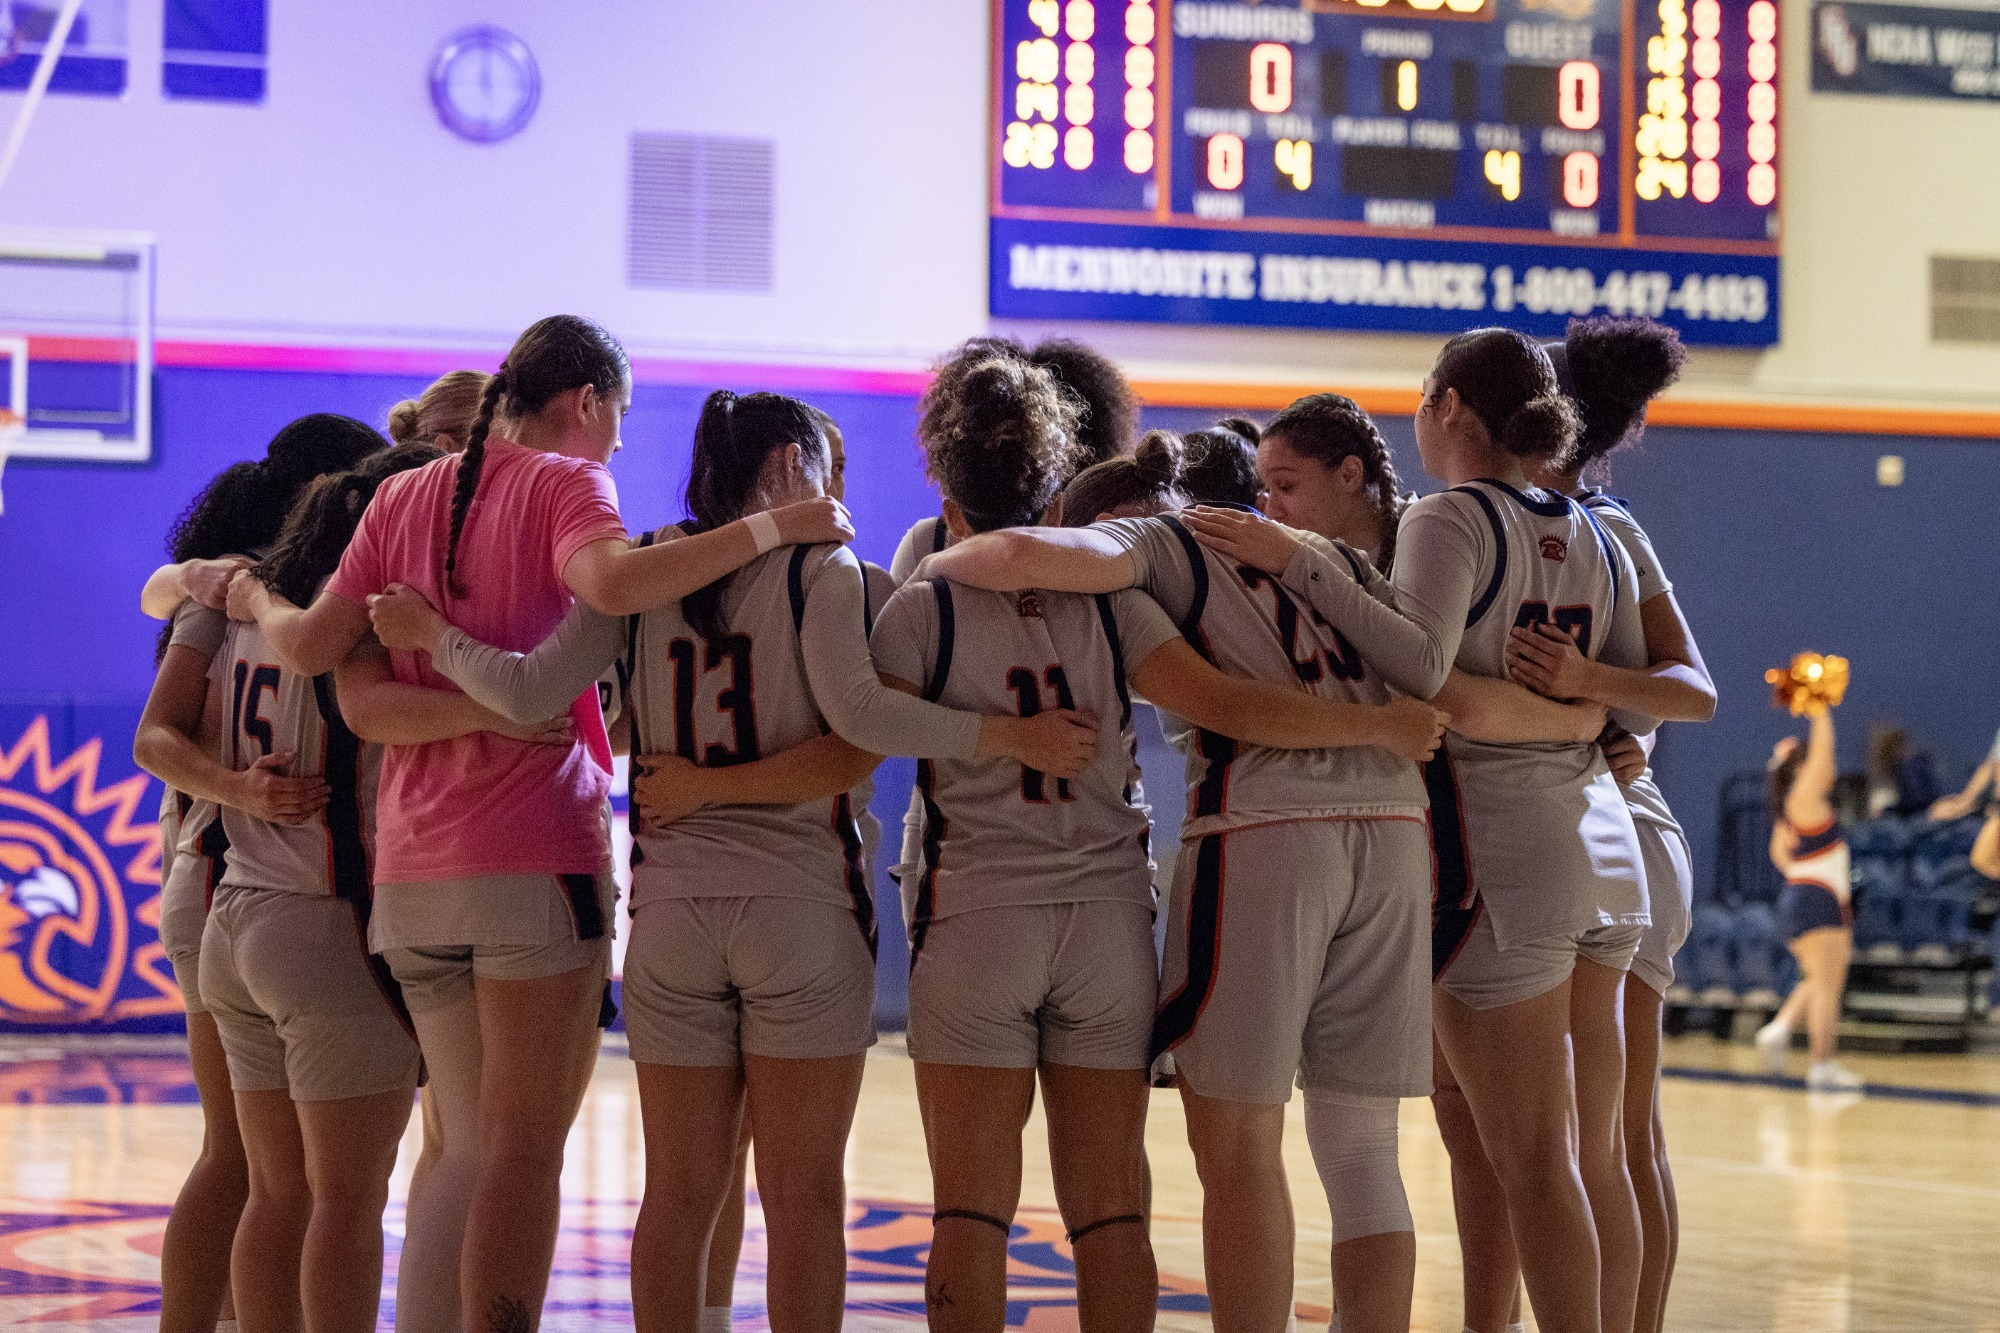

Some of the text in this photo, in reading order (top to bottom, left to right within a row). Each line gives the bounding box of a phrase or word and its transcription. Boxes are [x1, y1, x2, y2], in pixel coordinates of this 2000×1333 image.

[1174, 4, 1314, 44] SUNBIRDS
[1505, 20, 1593, 60] GUEST
[1250, 43, 1292, 112] 0
[1398, 60, 1417, 110] 1
[1559, 60, 1600, 129] 0
[1207, 133, 1244, 190] 0
[1274, 139, 1312, 190] 4
[1484, 149, 1520, 201] 4
[1563, 151, 1599, 207] 0
[1010, 243, 1256, 299] MENNONITE
[1260, 253, 1485, 311] INSURANCE
[232, 658, 281, 771] 15
[667, 632, 760, 768] 13
[1006, 663, 1077, 804] 11
